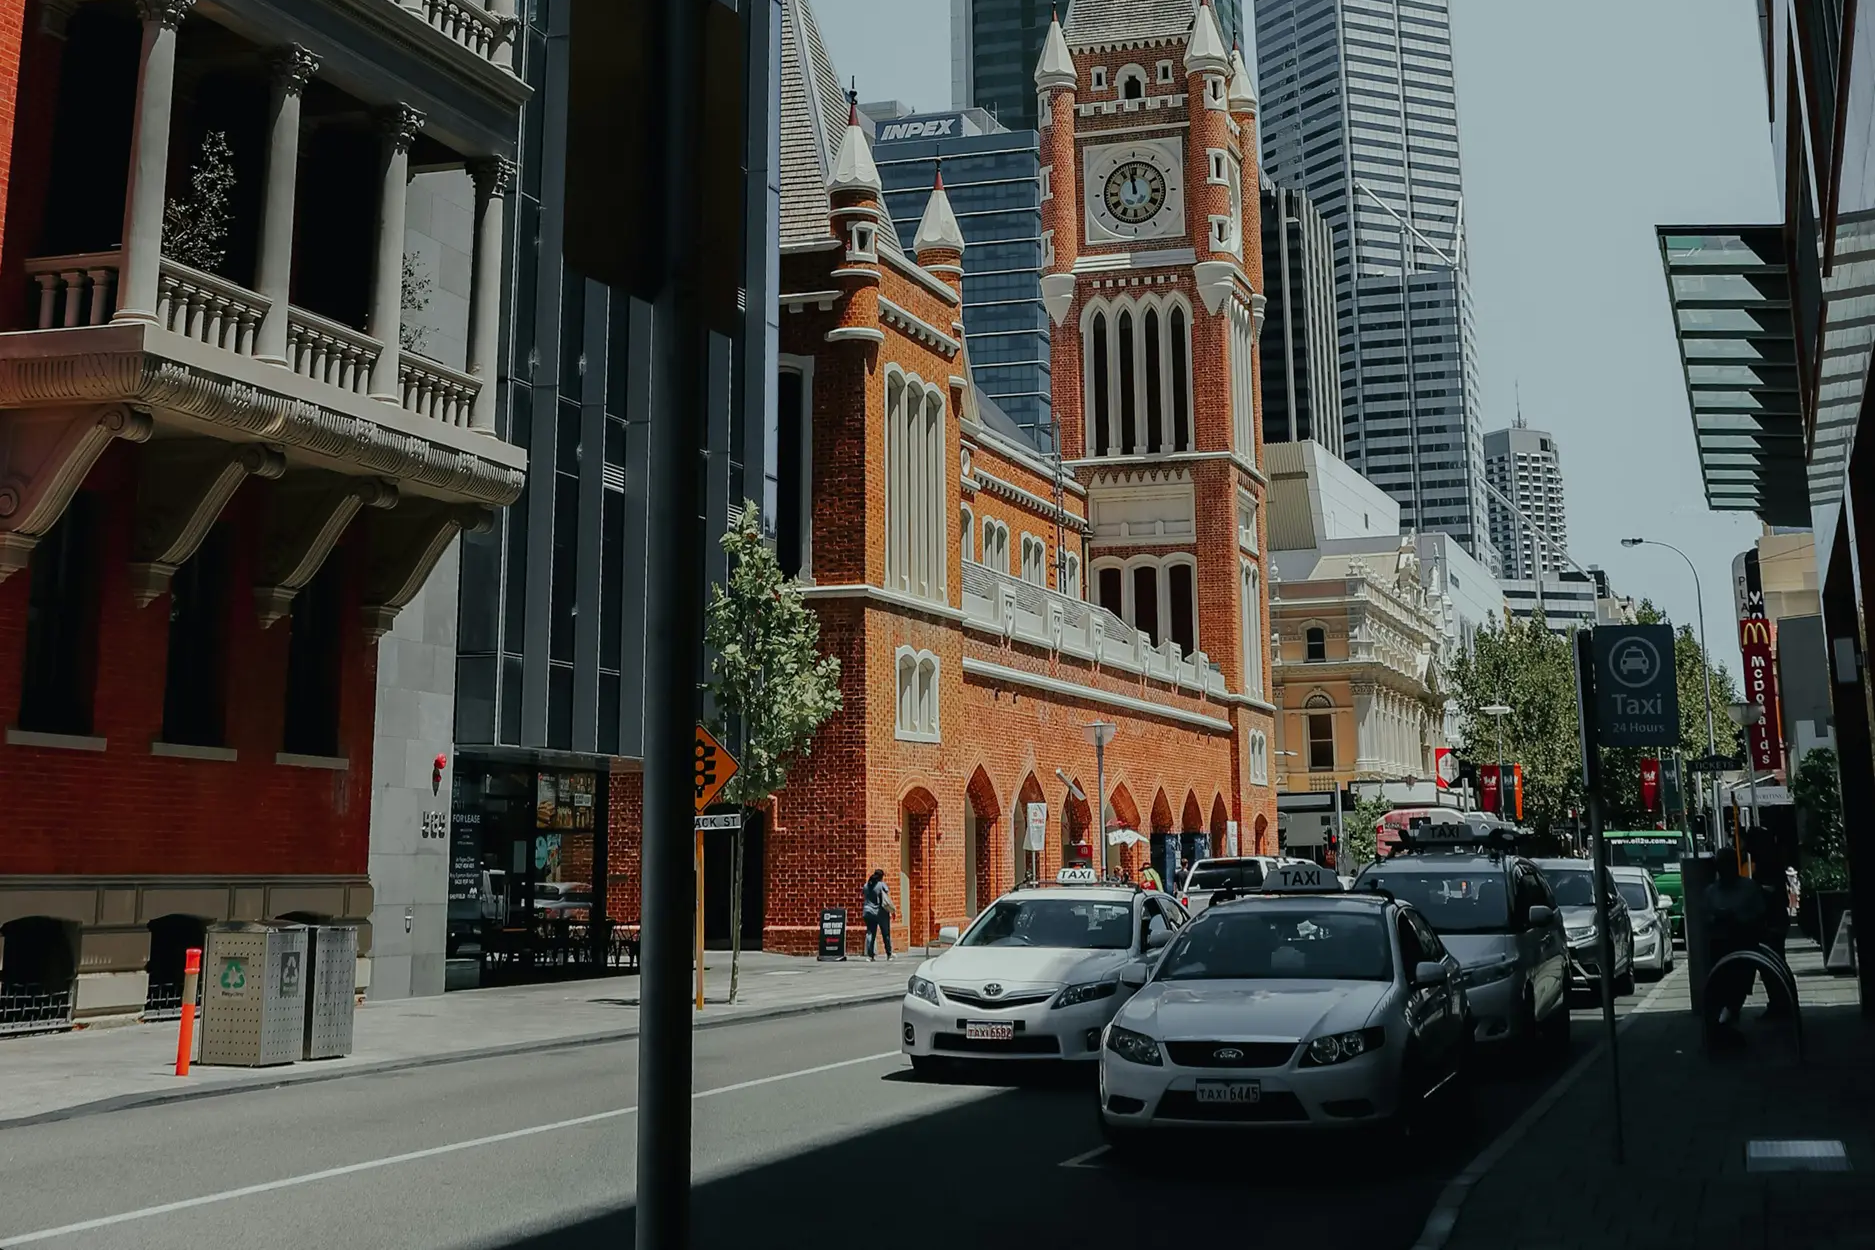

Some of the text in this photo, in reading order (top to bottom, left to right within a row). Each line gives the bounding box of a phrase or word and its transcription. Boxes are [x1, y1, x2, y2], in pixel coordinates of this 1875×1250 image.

[880, 118, 956, 141] INPEX
[1738, 576, 1752, 619] PLA
[1611, 693, 1662, 715] Taxi
[1612, 722, 1665, 734] 24 Hours
[452, 814, 481, 824] FOR LEASE
[723, 816, 737, 827] ST
[1430, 827, 1460, 838] TAXI
[1061, 870, 1092, 879] TAXI
[1279, 870, 1321, 886] TAXI
[1199, 1086, 1259, 1102] TAXI 6445
